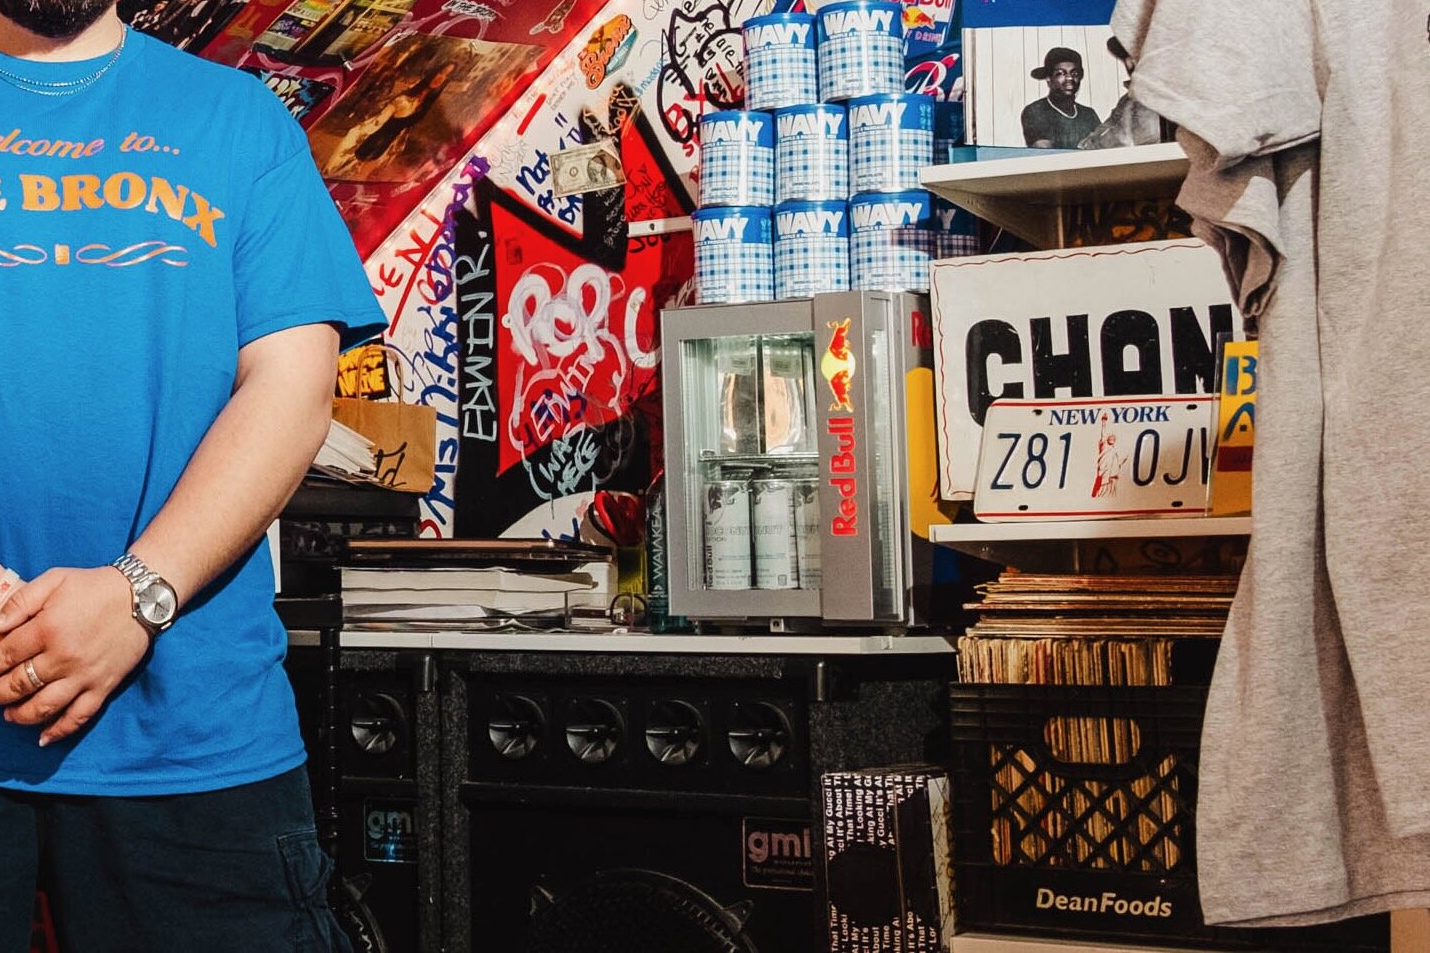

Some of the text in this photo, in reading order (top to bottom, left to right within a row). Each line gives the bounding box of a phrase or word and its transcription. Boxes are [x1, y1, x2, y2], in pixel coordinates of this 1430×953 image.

[823, 9, 894, 34] WAVY
[744, 22, 810, 49] WAVY
[778, 112, 844, 138] WAVY
[119, 132, 180, 156] to...
[19, 171, 226, 247] BRONX
[777, 209, 844, 235] WAVY
[852, 202, 922, 230] WAVY
[457, 294, 497, 441] EDWIN
[1049, 405, 1171, 426] NEW YORK
[990, 431, 1072, 490] Z81
[830, 416, 858, 536] Red Bull
[825, 788, 834, 817] Gucci
[834, 789, 843, 818] About
[856, 789, 864, 829] Looking
[864, 790, 874, 804] My
[826, 819, 835, 834] My
[876, 791, 885, 837] Gucci It's
[846, 818, 854, 841] That
